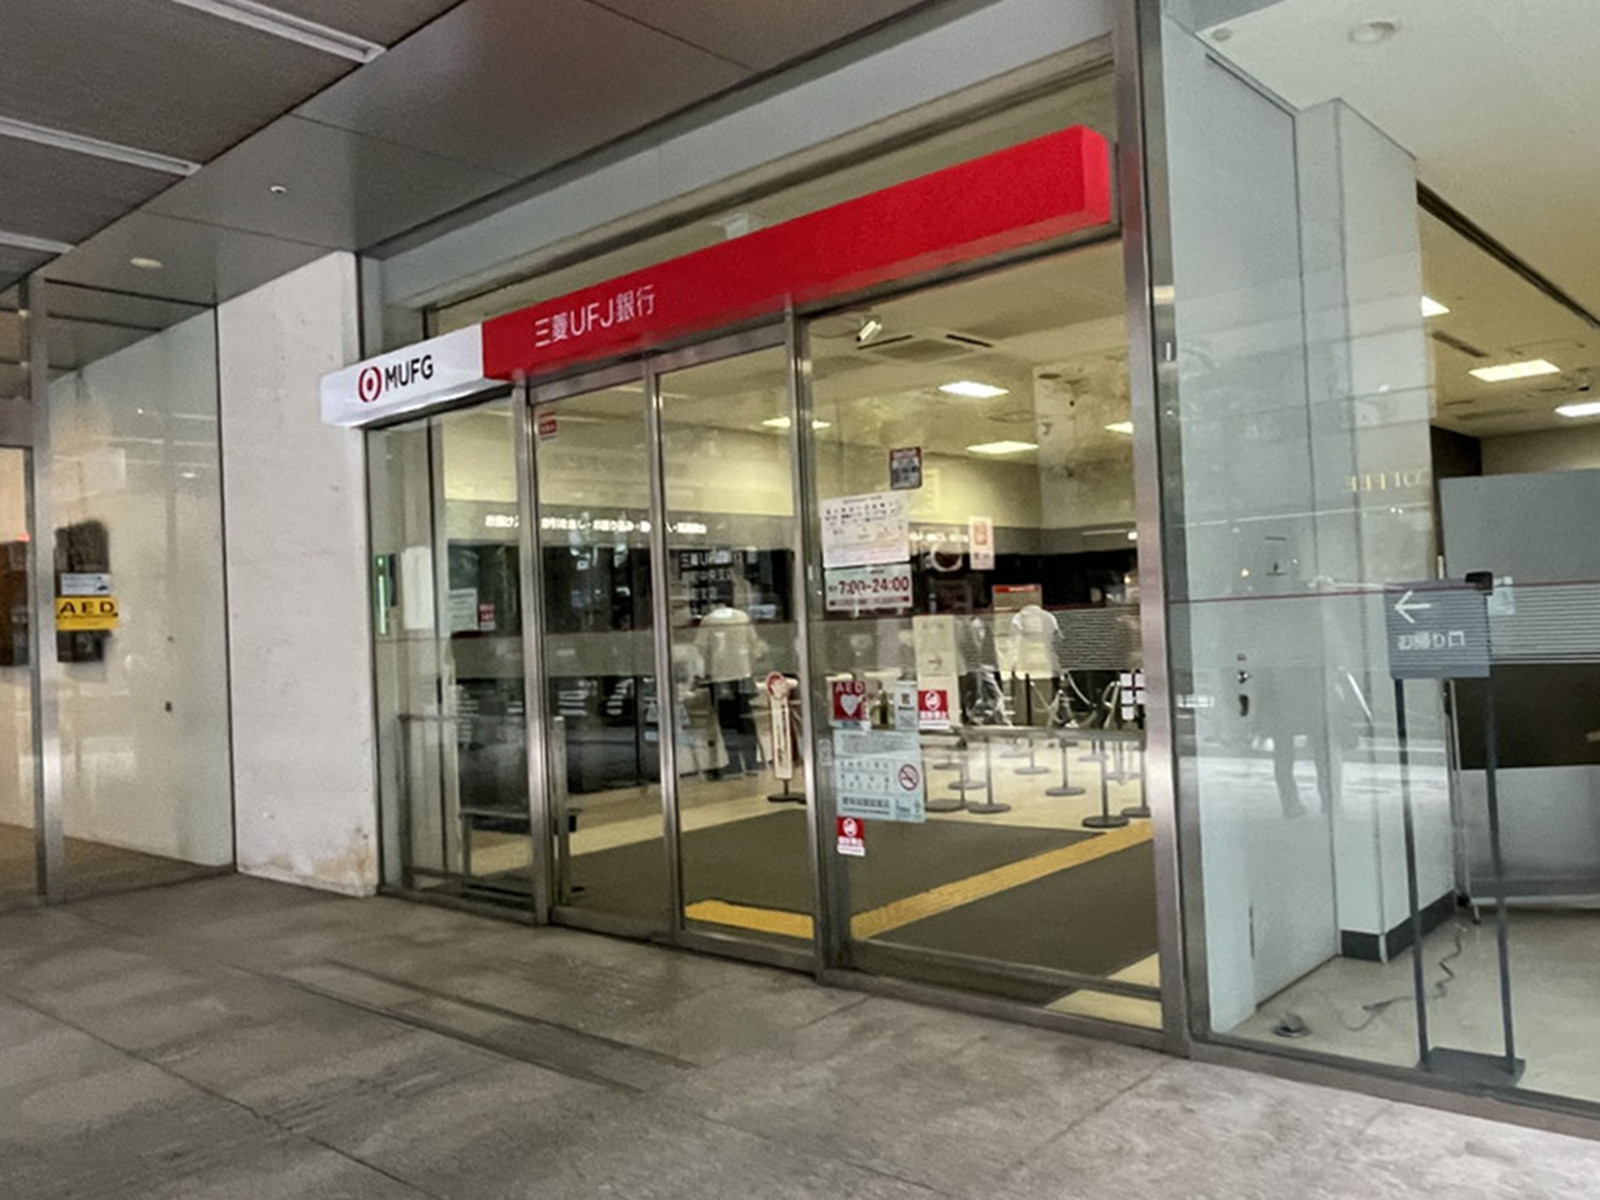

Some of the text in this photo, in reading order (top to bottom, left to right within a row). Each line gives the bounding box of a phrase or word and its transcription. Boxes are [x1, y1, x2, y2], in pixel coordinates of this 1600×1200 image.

[535, 285, 655, 347] 三菱UFJ銀行
[385, 354, 433, 391] MUFG
[60, 601, 115, 614] AED
